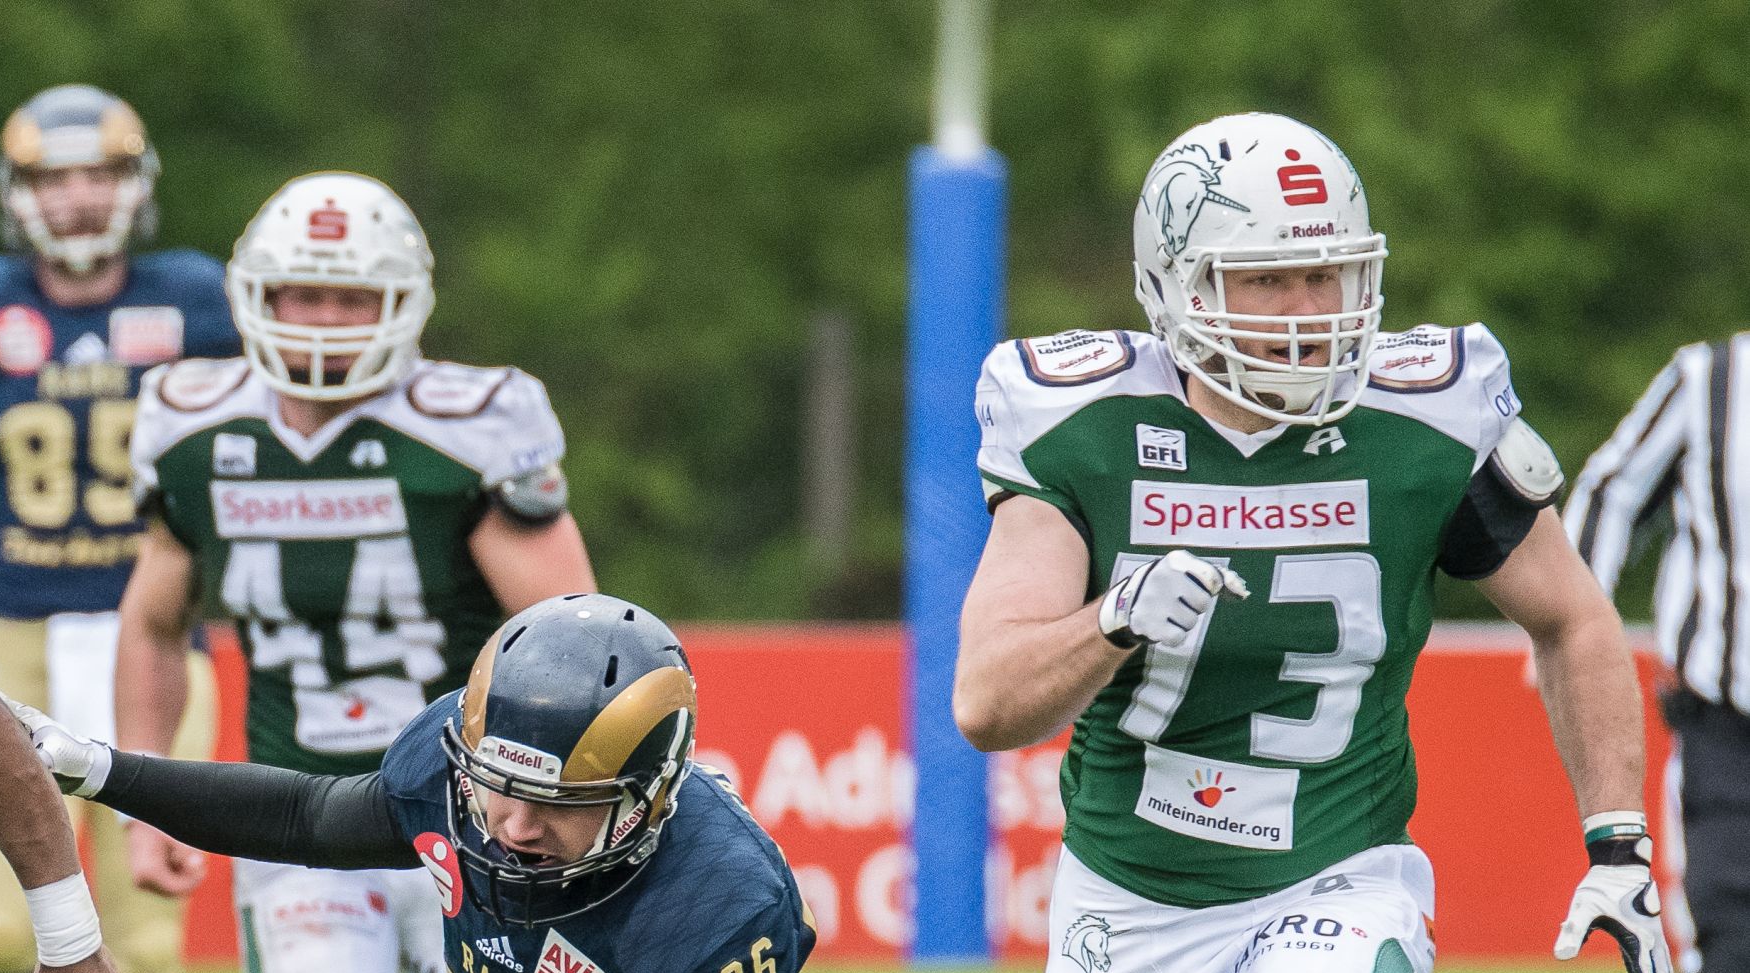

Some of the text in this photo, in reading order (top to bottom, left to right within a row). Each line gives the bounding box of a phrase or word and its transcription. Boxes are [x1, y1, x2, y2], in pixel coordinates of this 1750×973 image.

[1292, 221, 1335, 238] Riddell
[1142, 444, 1182, 464] GFL
[222, 490, 393, 525] Sparkasse
[1143, 493, 1356, 535] Sparkasse
[220, 537, 448, 689] 44
[1116, 552, 1387, 764] 73
[498, 745, 543, 769] Riddell
[610, 808, 646, 845] iddell
[1147, 796, 1281, 842] miteinander.org
[476, 939, 524, 973] adidas
[1284, 941, 1335, 951] 1969
